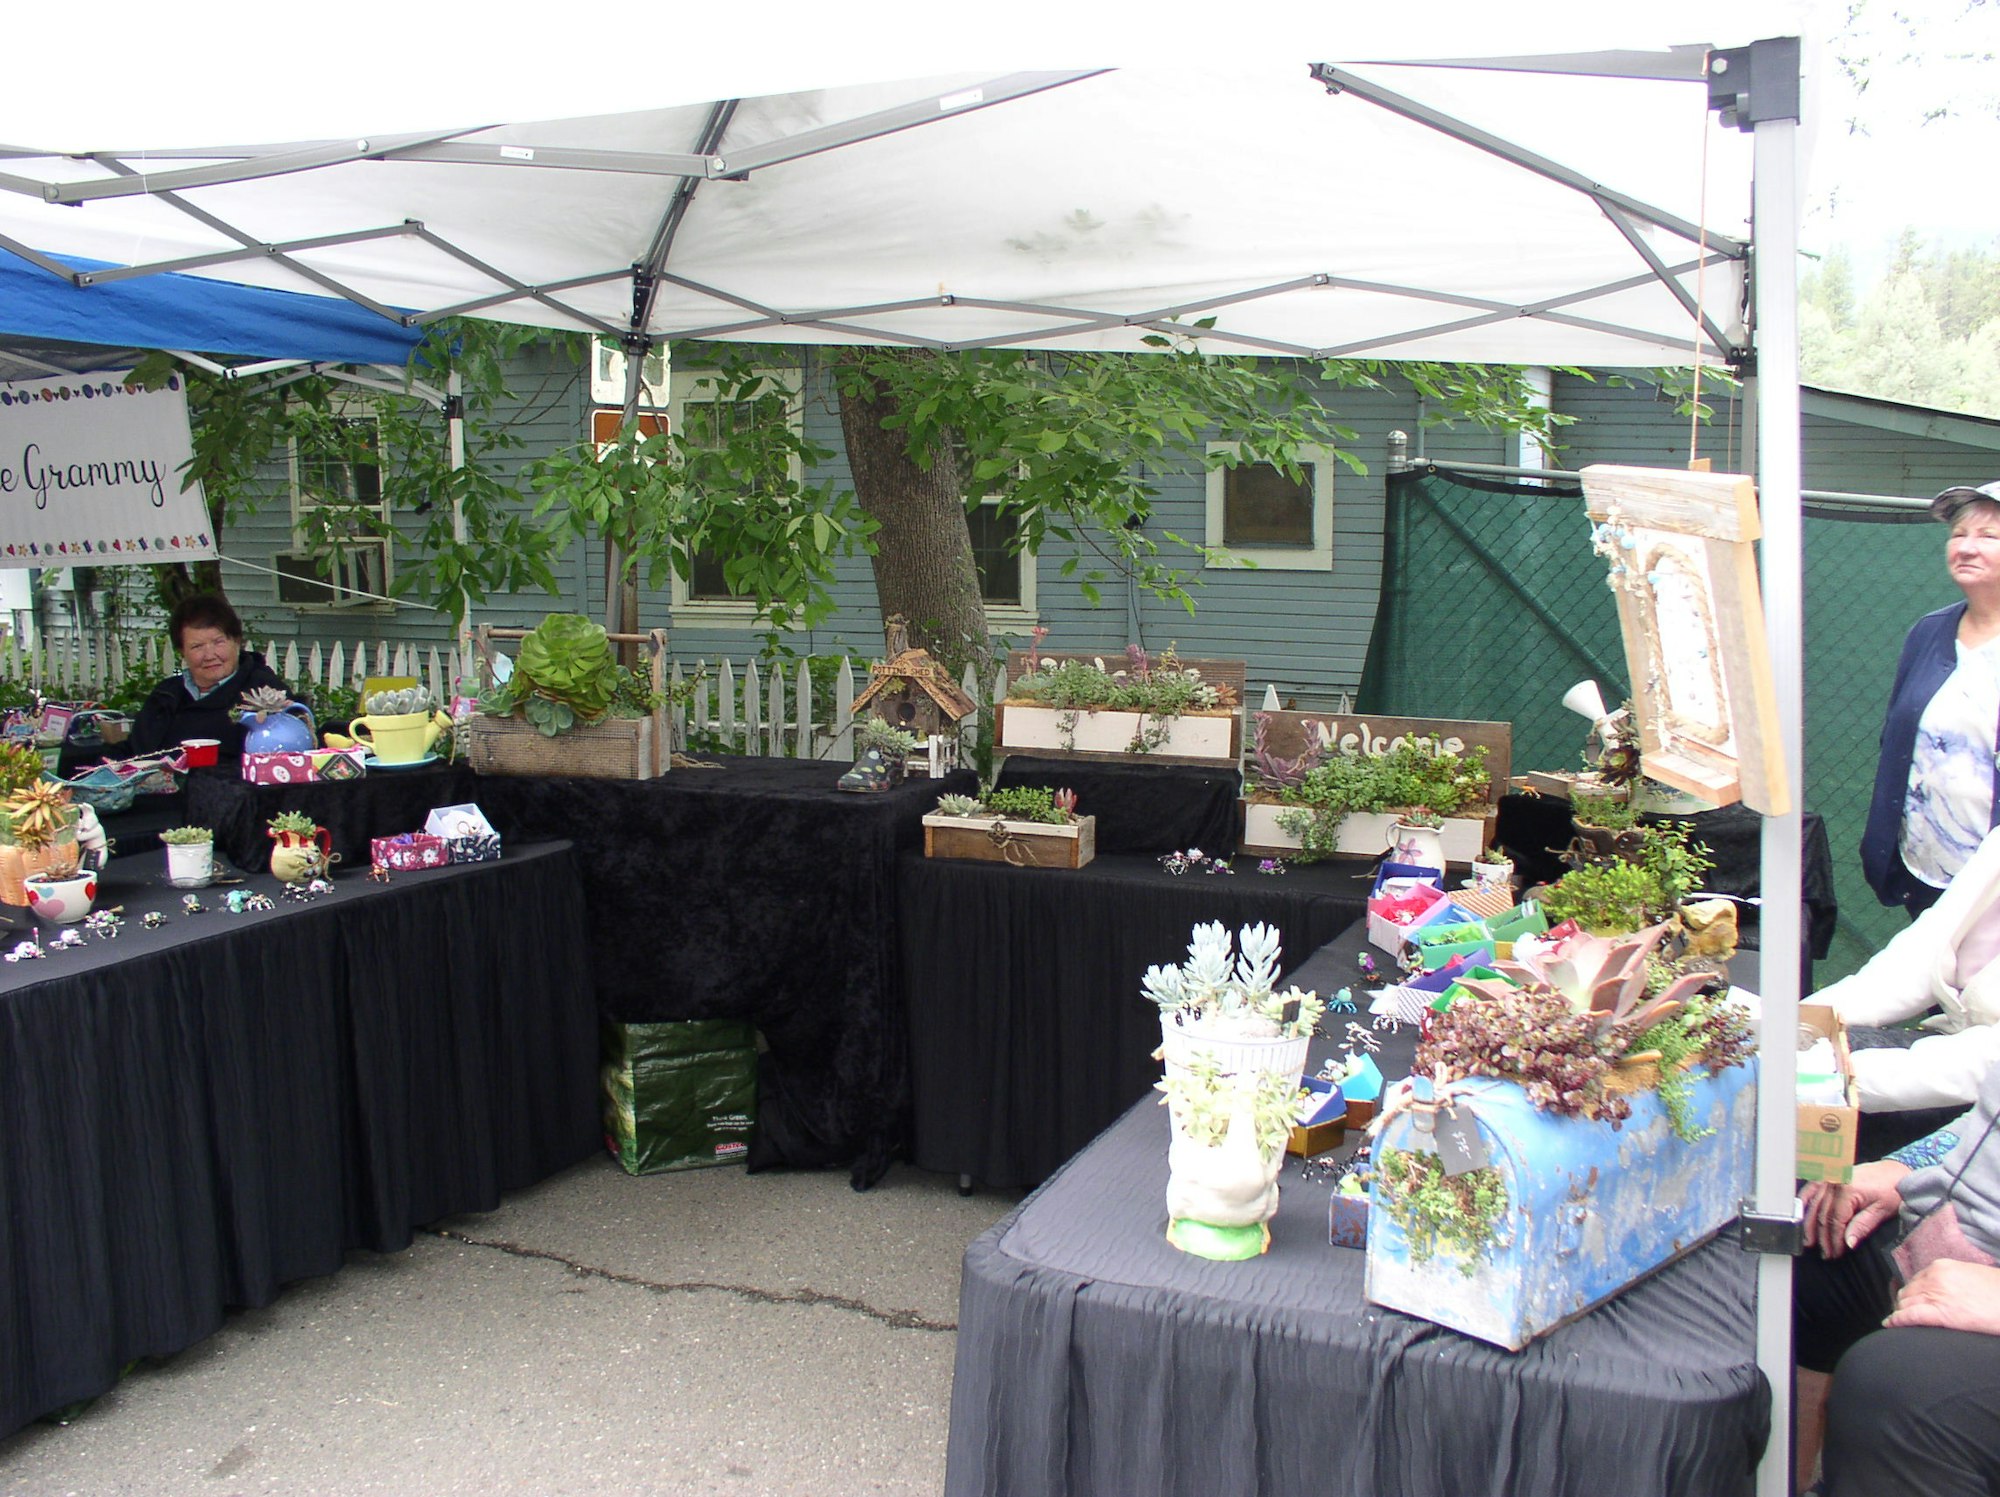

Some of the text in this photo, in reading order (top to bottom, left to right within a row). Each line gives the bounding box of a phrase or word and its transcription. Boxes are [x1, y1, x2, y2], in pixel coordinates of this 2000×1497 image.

[23, 443, 167, 511] Grammy
[872, 665, 931, 676] POTTING SHED
